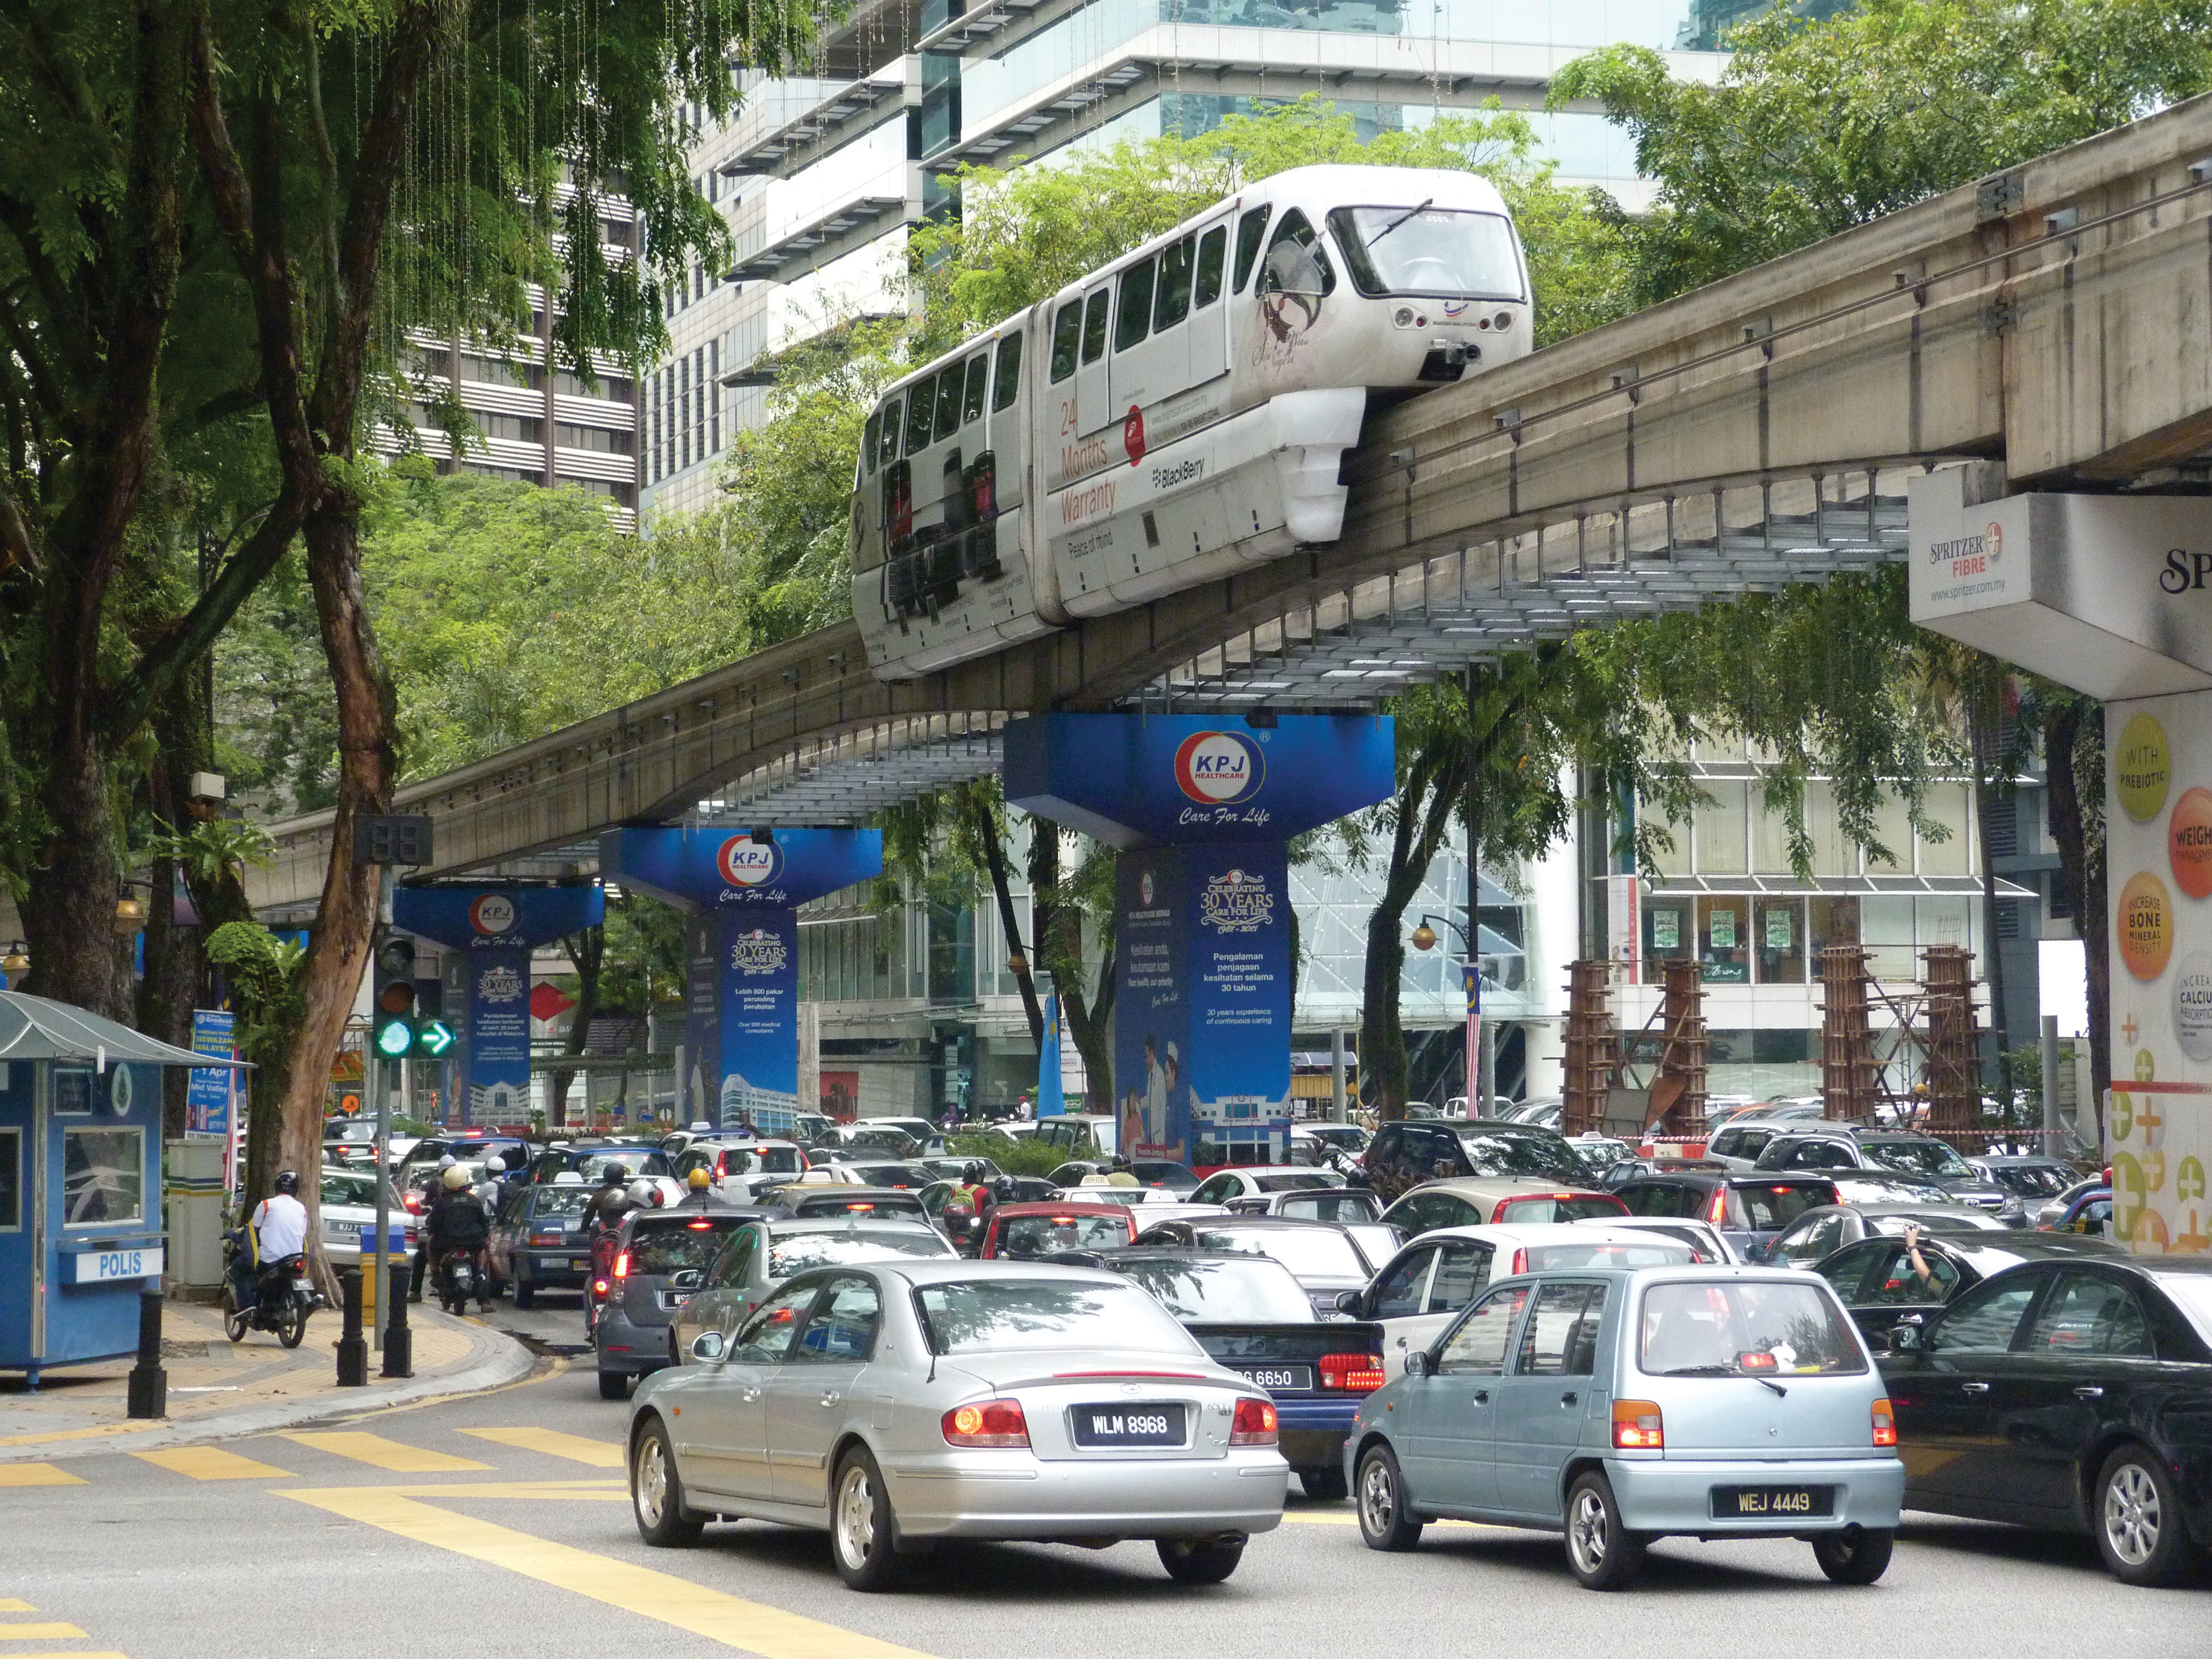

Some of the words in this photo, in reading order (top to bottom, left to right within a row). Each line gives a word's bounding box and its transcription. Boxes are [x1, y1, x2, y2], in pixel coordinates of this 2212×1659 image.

[1061, 398, 1075, 436] 24
[1061, 438, 1108, 480] Months
[1162, 458, 1204, 488] BlackBerry
[1061, 476, 1116, 525] Warranty
[1068, 540, 1089, 560] Peace
[1089, 534, 1096, 552] of
[1096, 527, 1114, 550] mind
[1929, 536, 1983, 564] SPRITZER
[1953, 556, 1986, 578] FIBRE
[1931, 580, 2005, 601] www.spritzer.com.my
[2126, 747, 2158, 765] WITH
[1196, 756, 1245, 772] KPJ
[2120, 770, 2165, 789] PREBIOTIC
[1179, 807, 1210, 825] Care
[1215, 807, 1238, 824] For
[1242, 807, 1270, 826] Life
[733, 853, 769, 864] KPJ
[1207, 884, 1265, 892] CELEBRATING
[719, 889, 742, 902] Care
[746, 889, 763, 902] For
[765, 889, 786, 903] Life
[1201, 893, 1220, 908] 30
[1223, 893, 1273, 908] YEARS
[2129, 896, 2160, 910] INCREASE
[482, 907, 511, 917] KPJ
[1231, 907, 1248, 916] FOR
[1250, 907, 1267, 916] LIFE
[2130, 912, 2161, 927] BONE
[472, 937, 491, 947] Care
[493, 937, 506, 946] For
[508, 937, 525, 947] Life
[2130, 930, 2161, 941] MINERAL
[732, 945, 746, 957] 30
[749, 946, 786, 957] YEARS
[2129, 941, 2161, 954] DENSITY
[1214, 953, 1263, 962] Pengalaman
[1218, 964, 1259, 972] penjagaan
[478, 979, 490, 989] 30
[493, 979, 523, 988] YEARS
[2180, 975, 2212, 989] INCREA
[2180, 991, 2212, 1004] CALCIU
[196, 1036, 232, 1044] SISWAZAH
[195, 1044, 231, 1052] MALAYSIA
[209, 1068, 227, 1078] Apr
[206, 1084, 228, 1094] Valley
[100, 1251, 141, 1277] POLIS
[1256, 1371, 1291, 1385] 6650
[1092, 1416, 1124, 1434] WLM
[1128, 1416, 1167, 1434] 8968
[1739, 1494, 1767, 1511] WEJ
[1773, 1493, 1810, 1511] 4449
